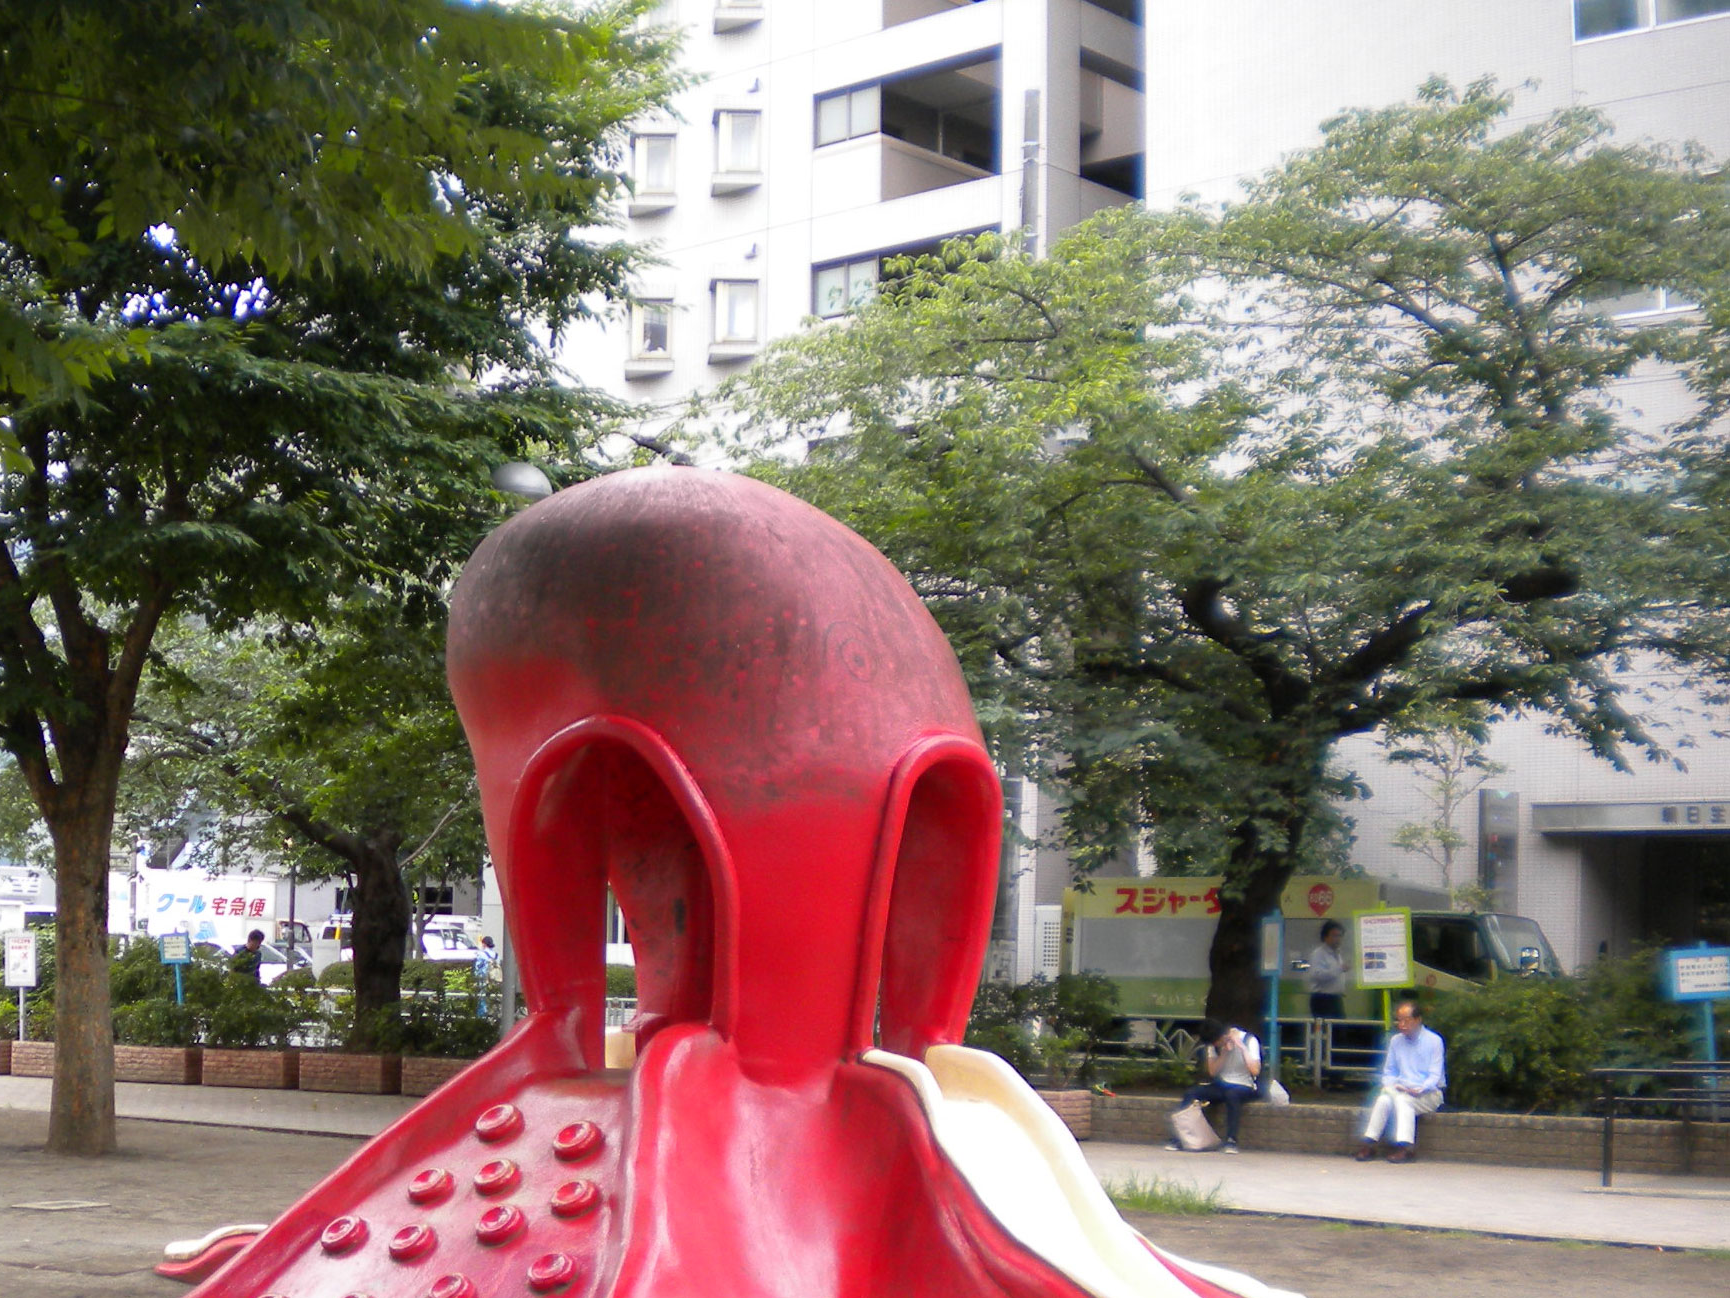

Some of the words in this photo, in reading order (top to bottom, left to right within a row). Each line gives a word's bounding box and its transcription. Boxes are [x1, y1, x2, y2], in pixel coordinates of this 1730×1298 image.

[157, 894, 206, 914] クール
[211, 897, 266, 917] 宅急便
